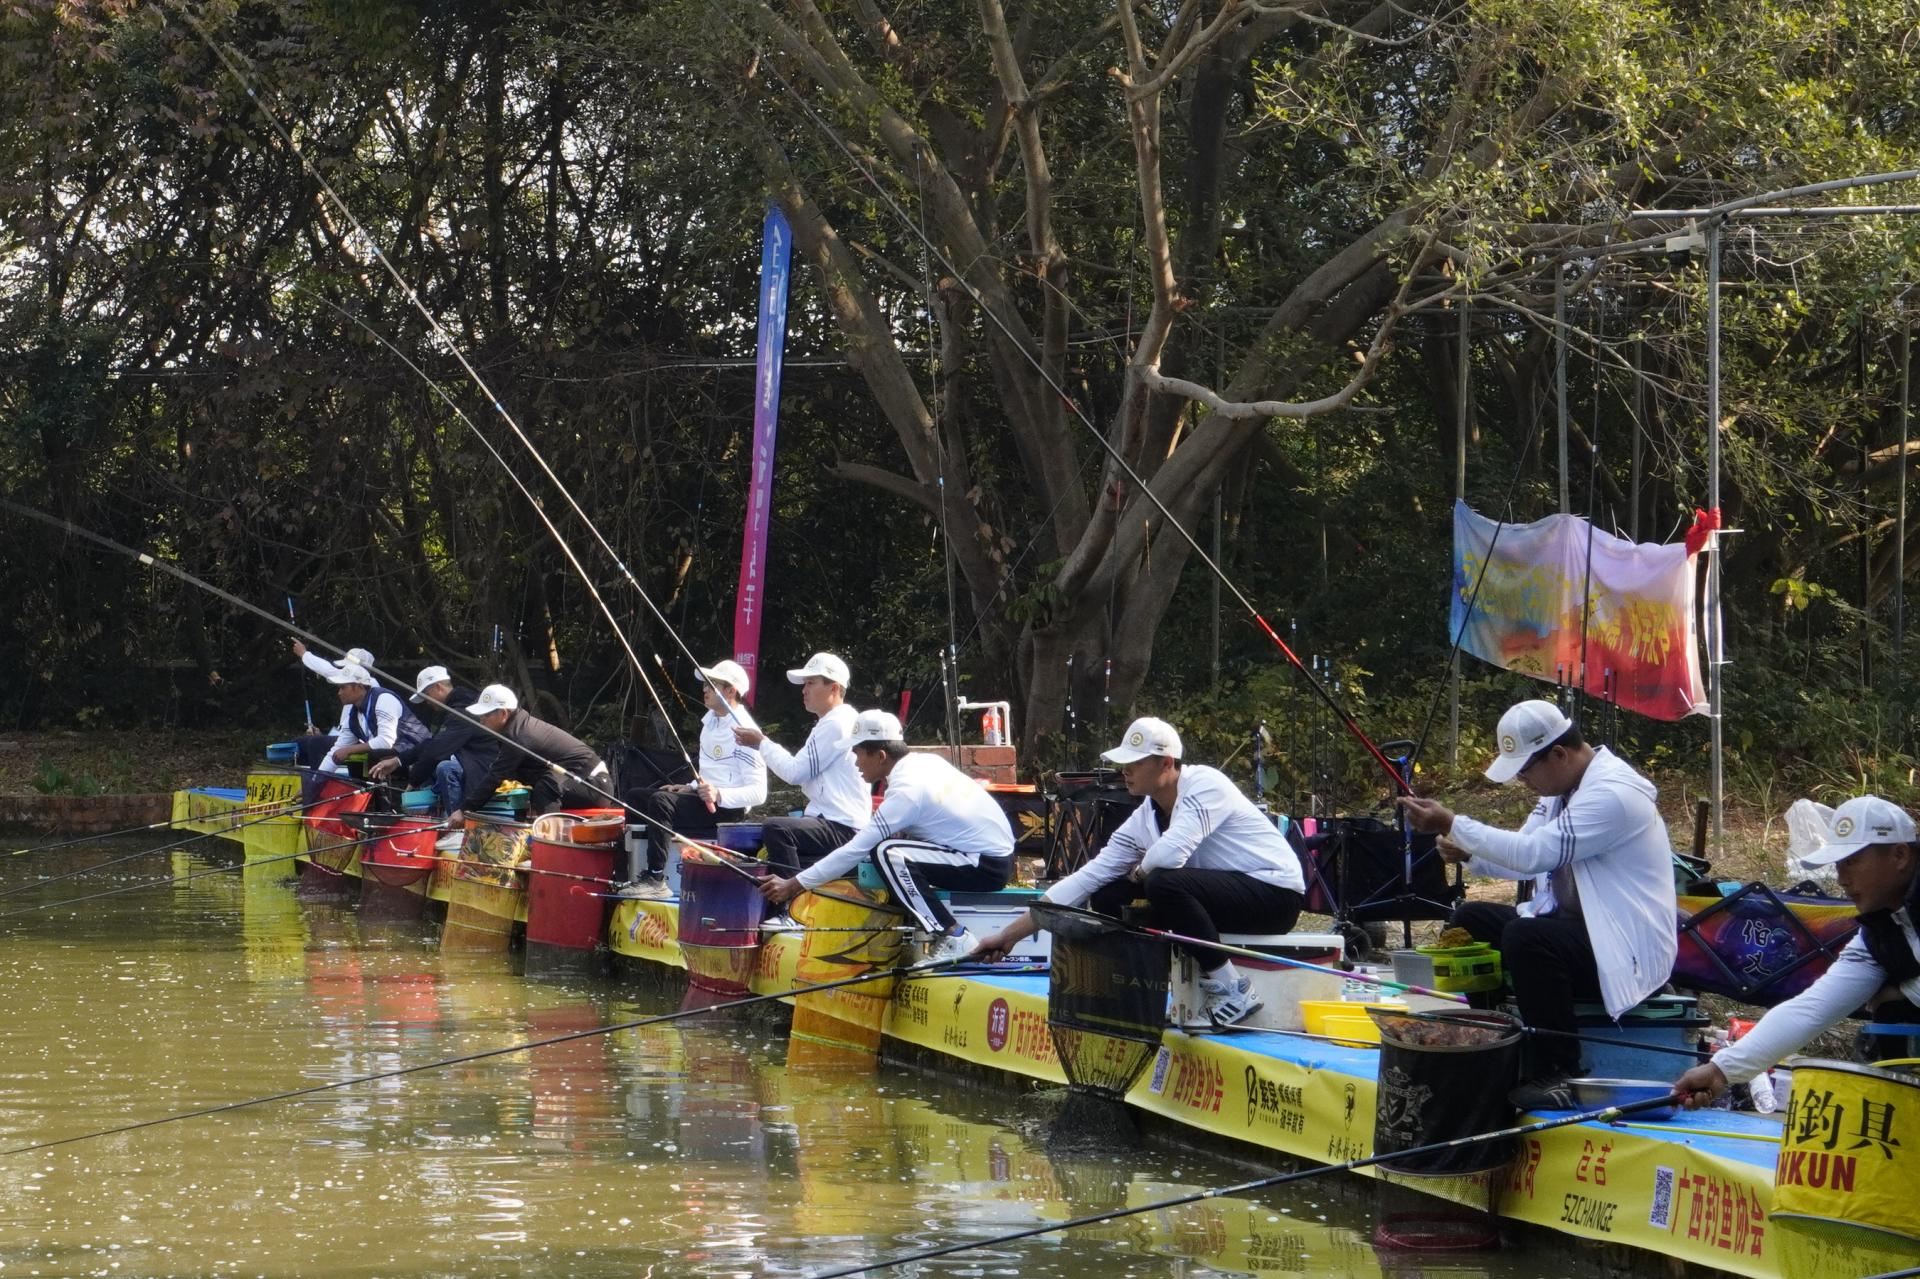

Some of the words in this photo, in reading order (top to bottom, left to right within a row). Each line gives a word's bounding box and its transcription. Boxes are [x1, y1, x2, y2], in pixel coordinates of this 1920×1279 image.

[1162, 1052, 1224, 1115] 广西钓鱼协会
[1561, 1193, 1618, 1233] SZCHANGE
[1671, 1167, 1764, 1258] 广西钓鱼协会
